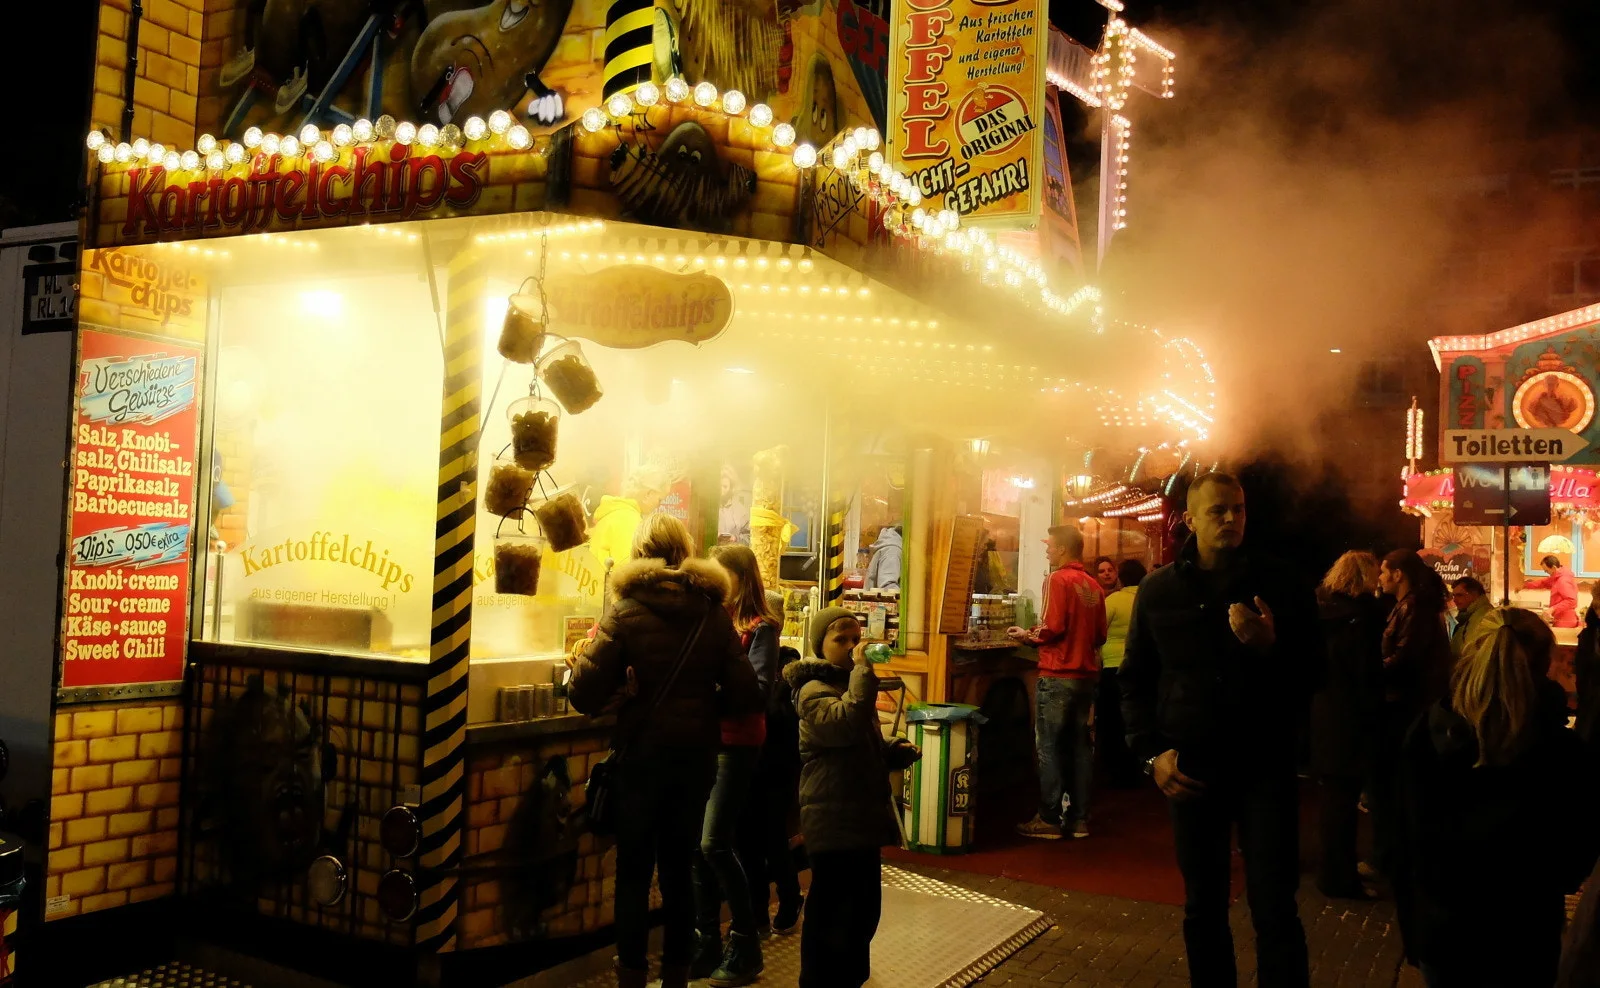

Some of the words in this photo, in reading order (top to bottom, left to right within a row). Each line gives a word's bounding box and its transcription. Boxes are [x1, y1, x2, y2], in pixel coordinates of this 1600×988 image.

[959, 15, 982, 31] Aus
[988, 9, 1034, 28] frischen
[976, 24, 1033, 43] Kartoffeln
[958, 49, 980, 64] und
[983, 46, 1021, 62] eigener
[967, 58, 1026, 80] Herstellung!
[902, 0, 953, 157] FFEL
[974, 108, 1007, 134] DAS
[961, 115, 1037, 160] ORIGINAL
[121, 143, 487, 236] Kartoffelchips
[943, 156, 1030, 215] GEFAHR!
[37, 297, 56, 319] RL
[131, 282, 194, 326] chips
[553, 285, 720, 334] artoffelchips
[95, 362, 183, 394] Verschiedene
[108, 383, 176, 422] Gewürze
[1457, 365, 1478, 430] PIZZ
[1453, 434, 1563, 457] Toiletten
[75, 468, 180, 497] Paprikasalz
[74, 491, 189, 519] Barbecuesalz
[77, 533, 115, 561] Dip's
[157, 531, 180, 550] extra
[239, 531, 414, 593] Kartoffelchips
[251, 587, 271, 599] aus
[275, 587, 317, 604] eigener
[321, 589, 389, 610] Herstellung
[476, 595, 494, 606] aus
[65, 639, 120, 661] Sweet
[123, 636, 166, 658] Chili
